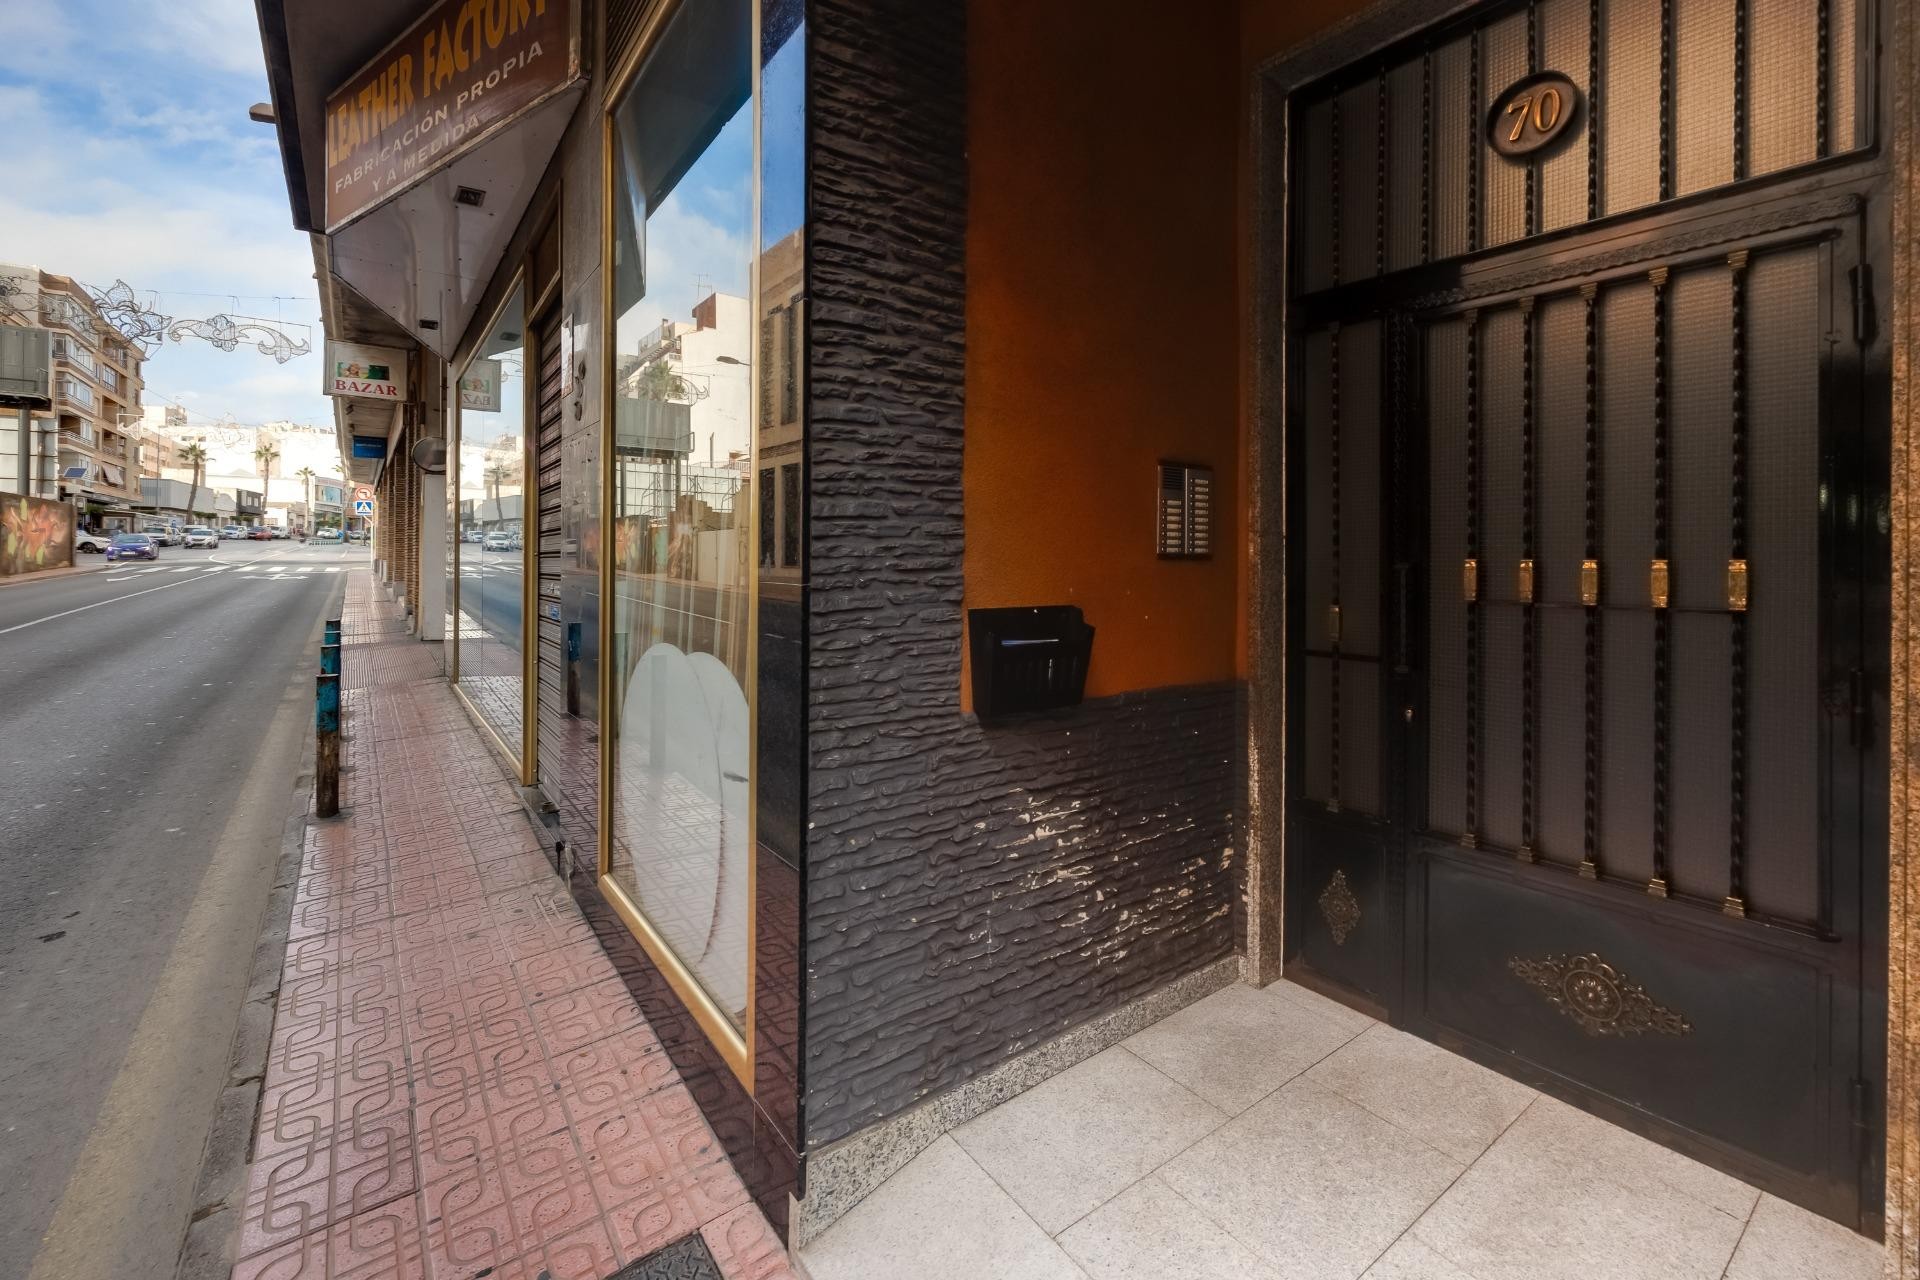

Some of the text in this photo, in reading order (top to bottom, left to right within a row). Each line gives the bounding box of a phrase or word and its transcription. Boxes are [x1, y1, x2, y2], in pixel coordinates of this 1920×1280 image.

[328, 0, 546, 169] LEATHER FACTO
[335, 41, 543, 194] FABRICACIÓN PROPIA
[1506, 88, 1561, 141] 70
[372, 113, 479, 192] Y A MEDIDA
[335, 379, 398, 396] BAZAR
